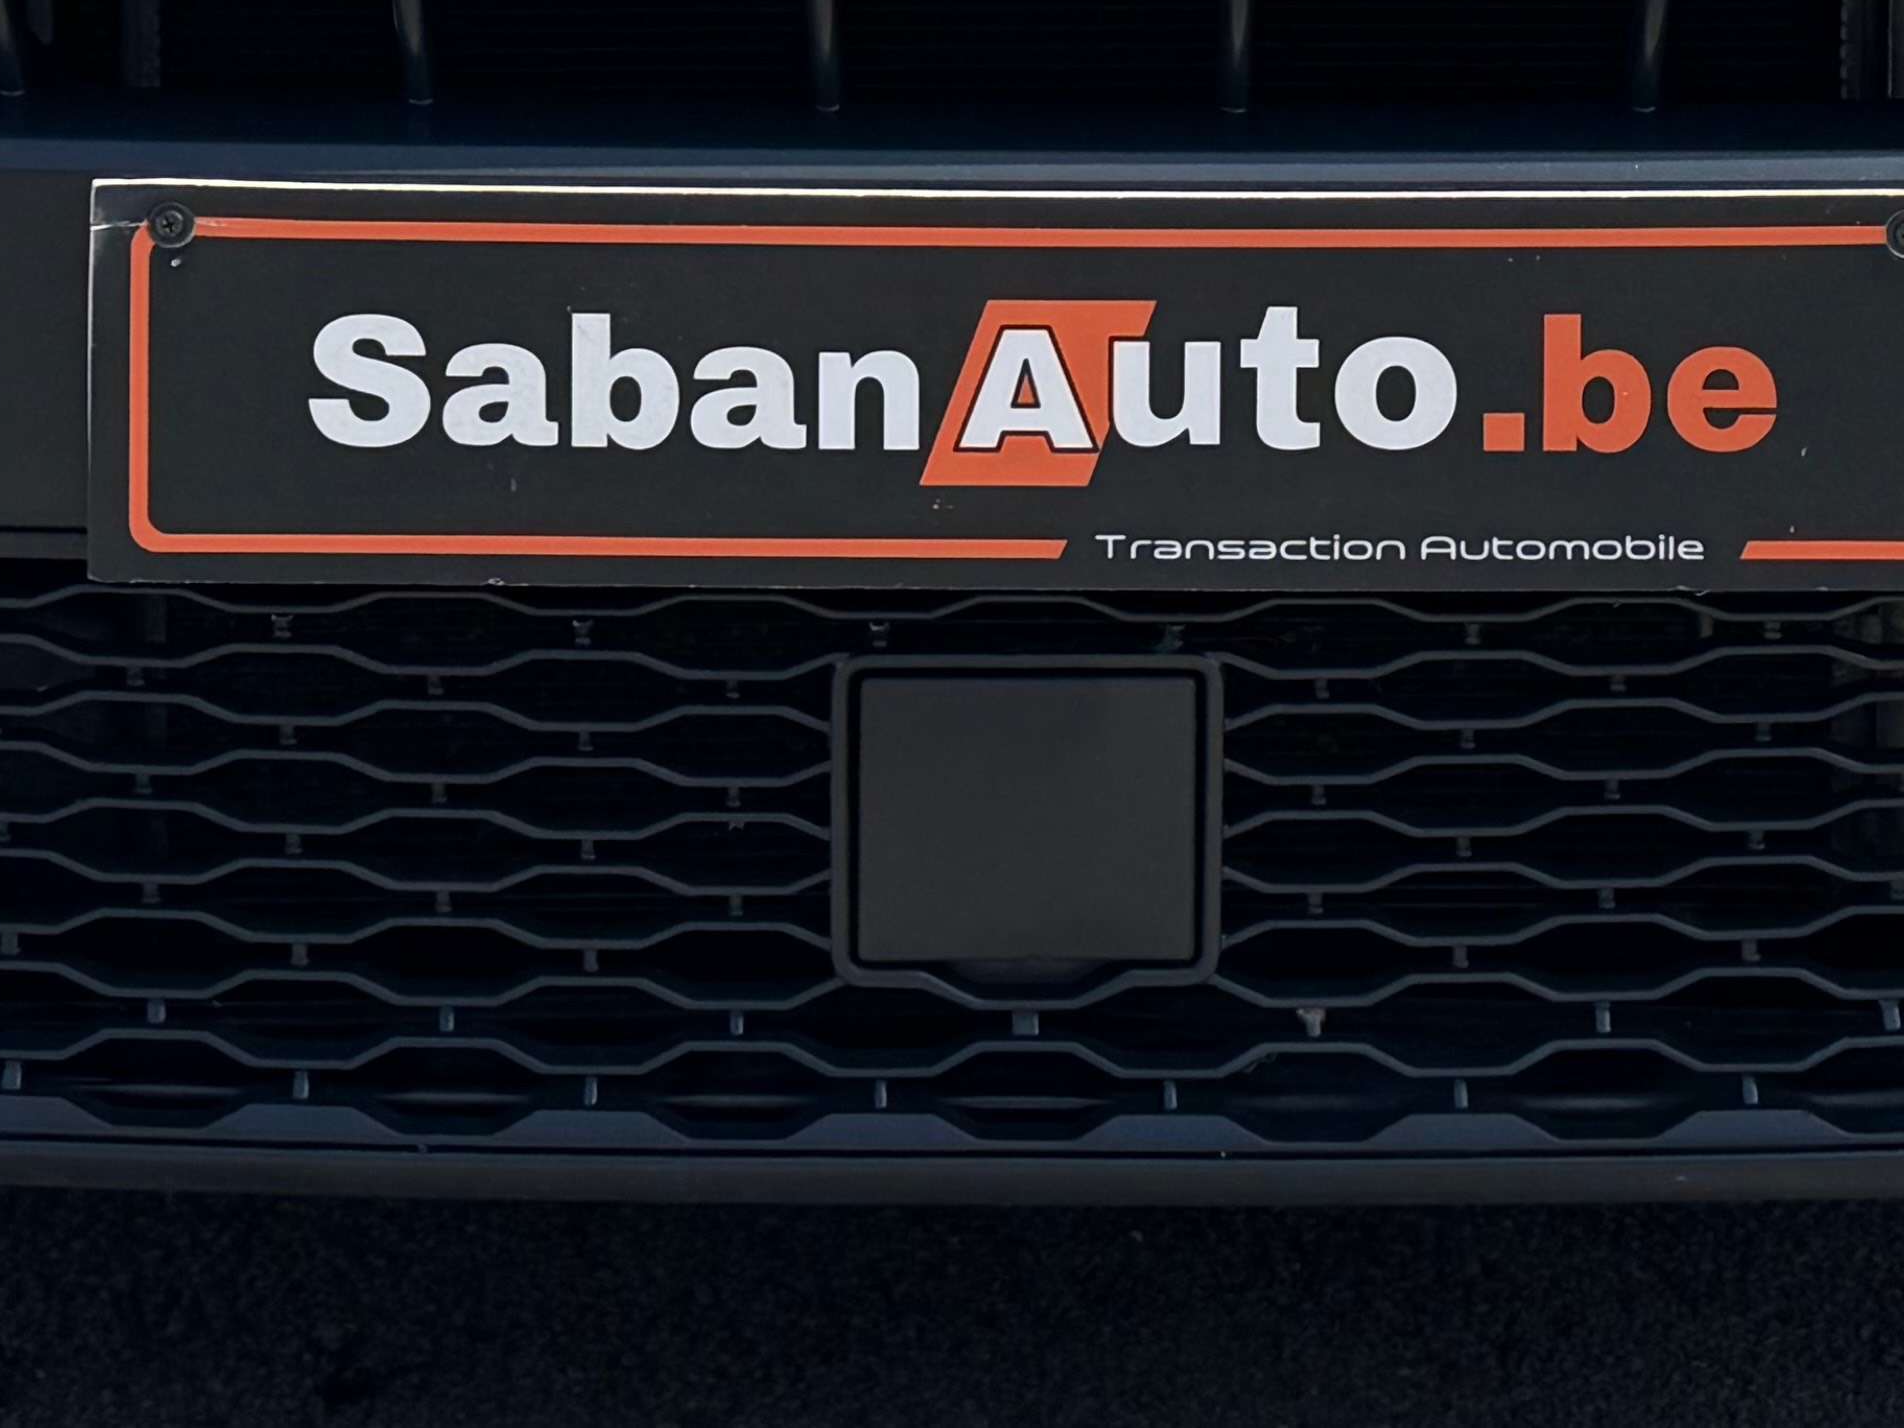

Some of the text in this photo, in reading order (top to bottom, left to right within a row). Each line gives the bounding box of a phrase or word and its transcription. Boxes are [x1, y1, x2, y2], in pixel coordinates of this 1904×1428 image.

[307, 305, 1778, 453] SabanAuto.be
[1095, 533, 1704, 562] Transaction Automobile
